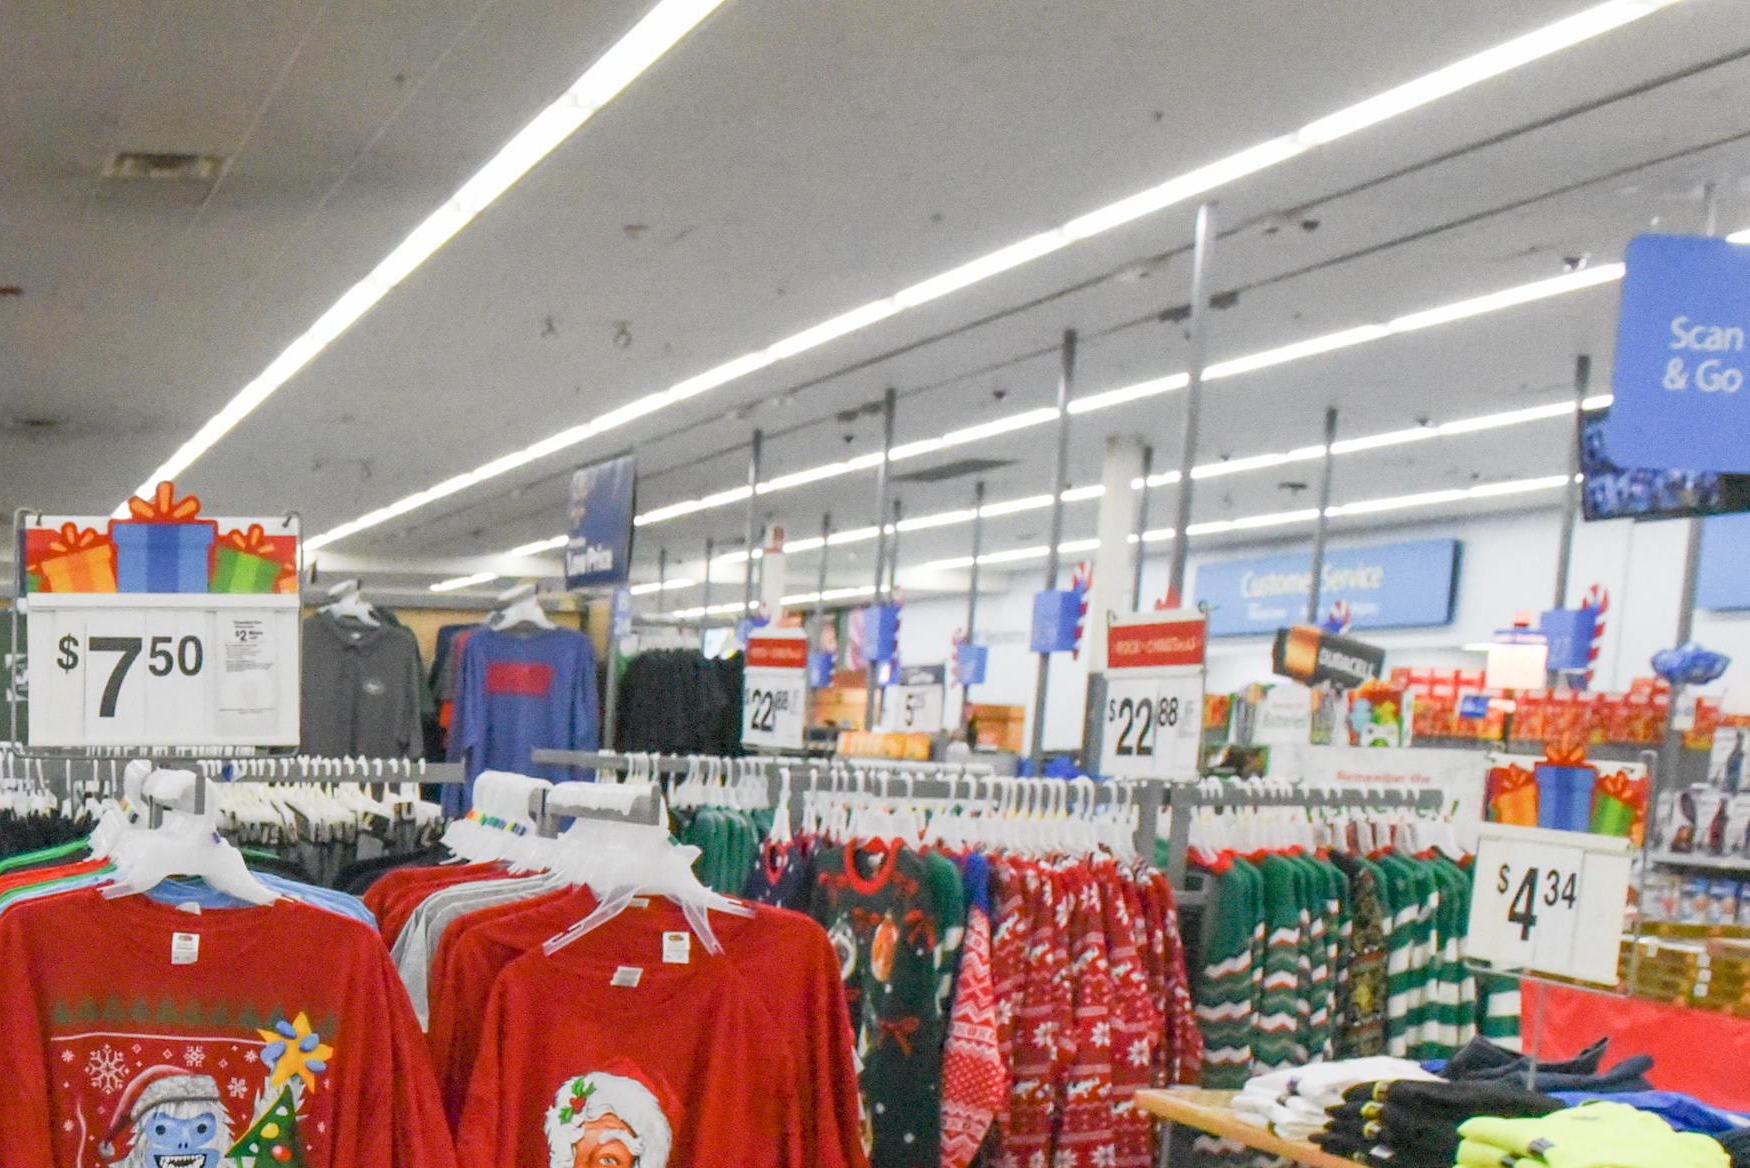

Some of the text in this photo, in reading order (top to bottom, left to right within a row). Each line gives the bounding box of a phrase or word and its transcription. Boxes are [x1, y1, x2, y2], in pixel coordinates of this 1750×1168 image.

[1669, 315, 1745, 351] Scan
[1662, 356, 1743, 393] & Go
[1241, 570, 1314, 598] Custome
